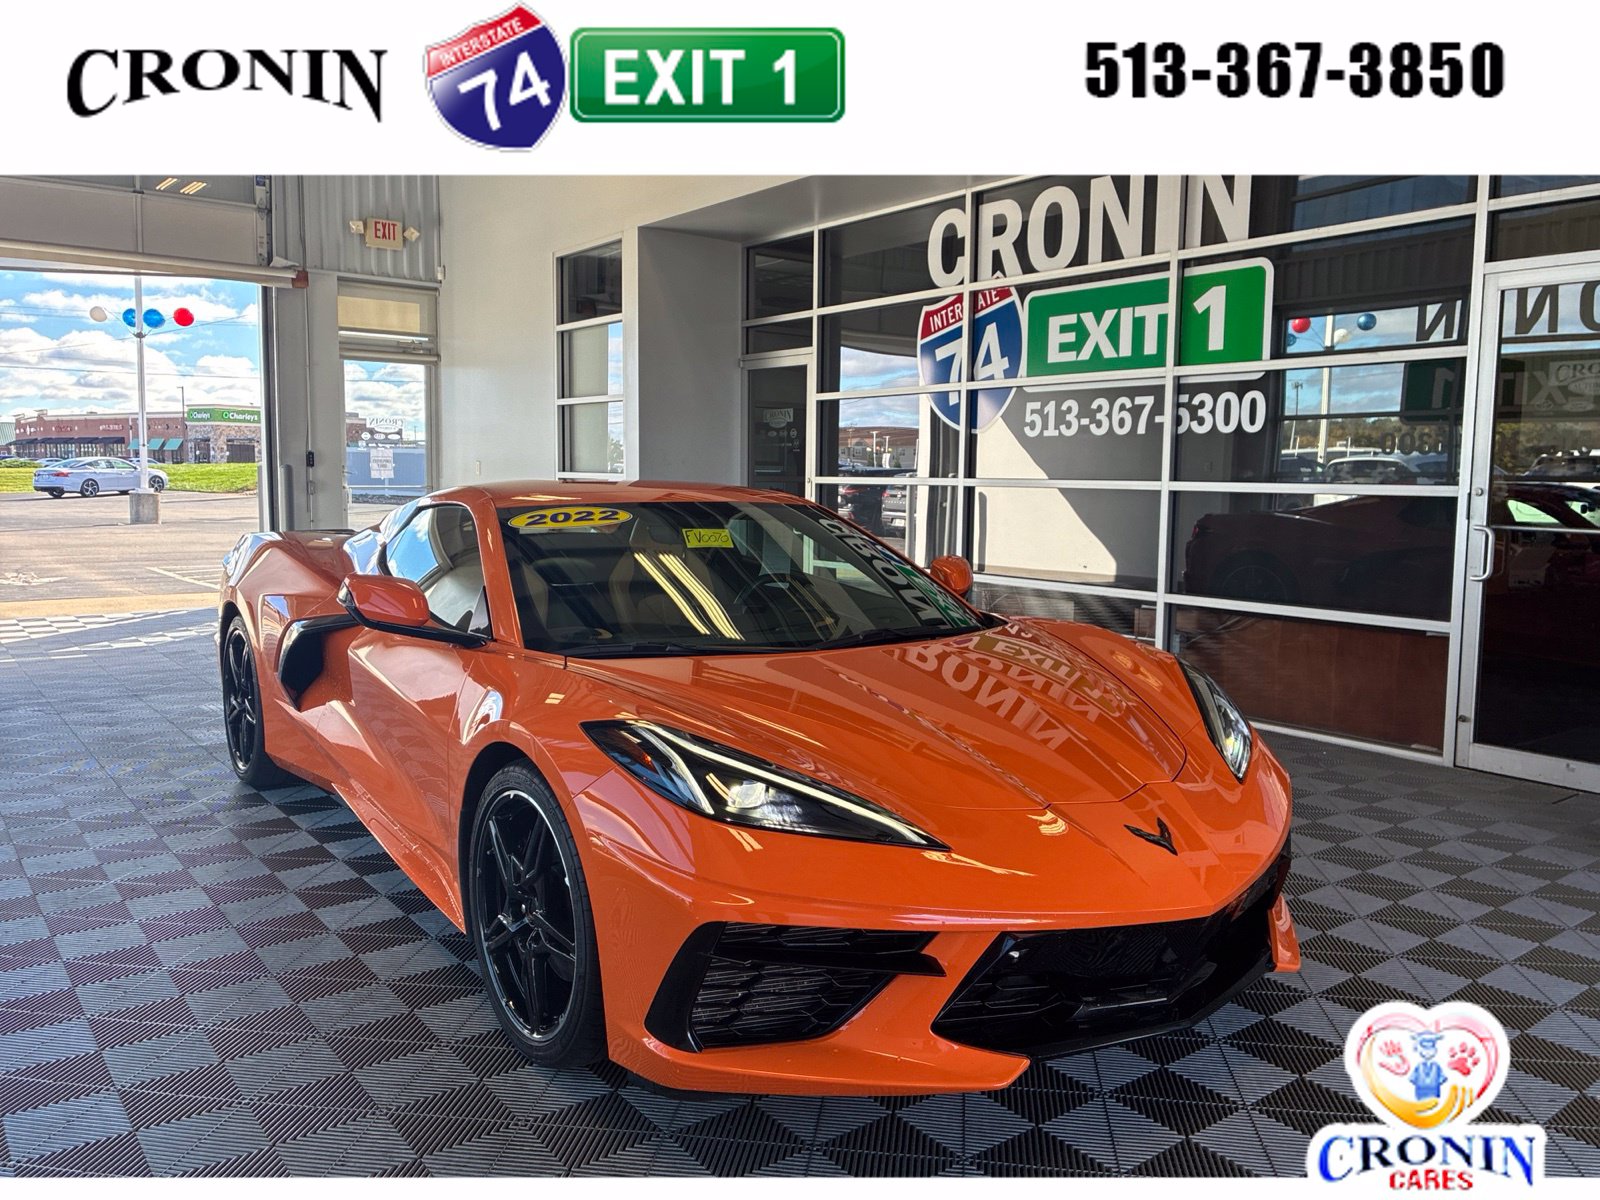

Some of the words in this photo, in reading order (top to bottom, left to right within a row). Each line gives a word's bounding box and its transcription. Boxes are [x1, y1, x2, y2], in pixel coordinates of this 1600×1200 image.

[374, 221, 397, 240] EXIT
[927, 175, 1252, 289] CRONIN
[929, 288, 1000, 333] INTERATE
[1047, 302, 1169, 363] EXIT
[1193, 285, 1226, 351] 1
[934, 320, 1010, 407] 74
[229, 412, 258, 422] Charleys
[1023, 390, 1266, 437] 513-367-5300
[525, 510, 620, 527] 2022
